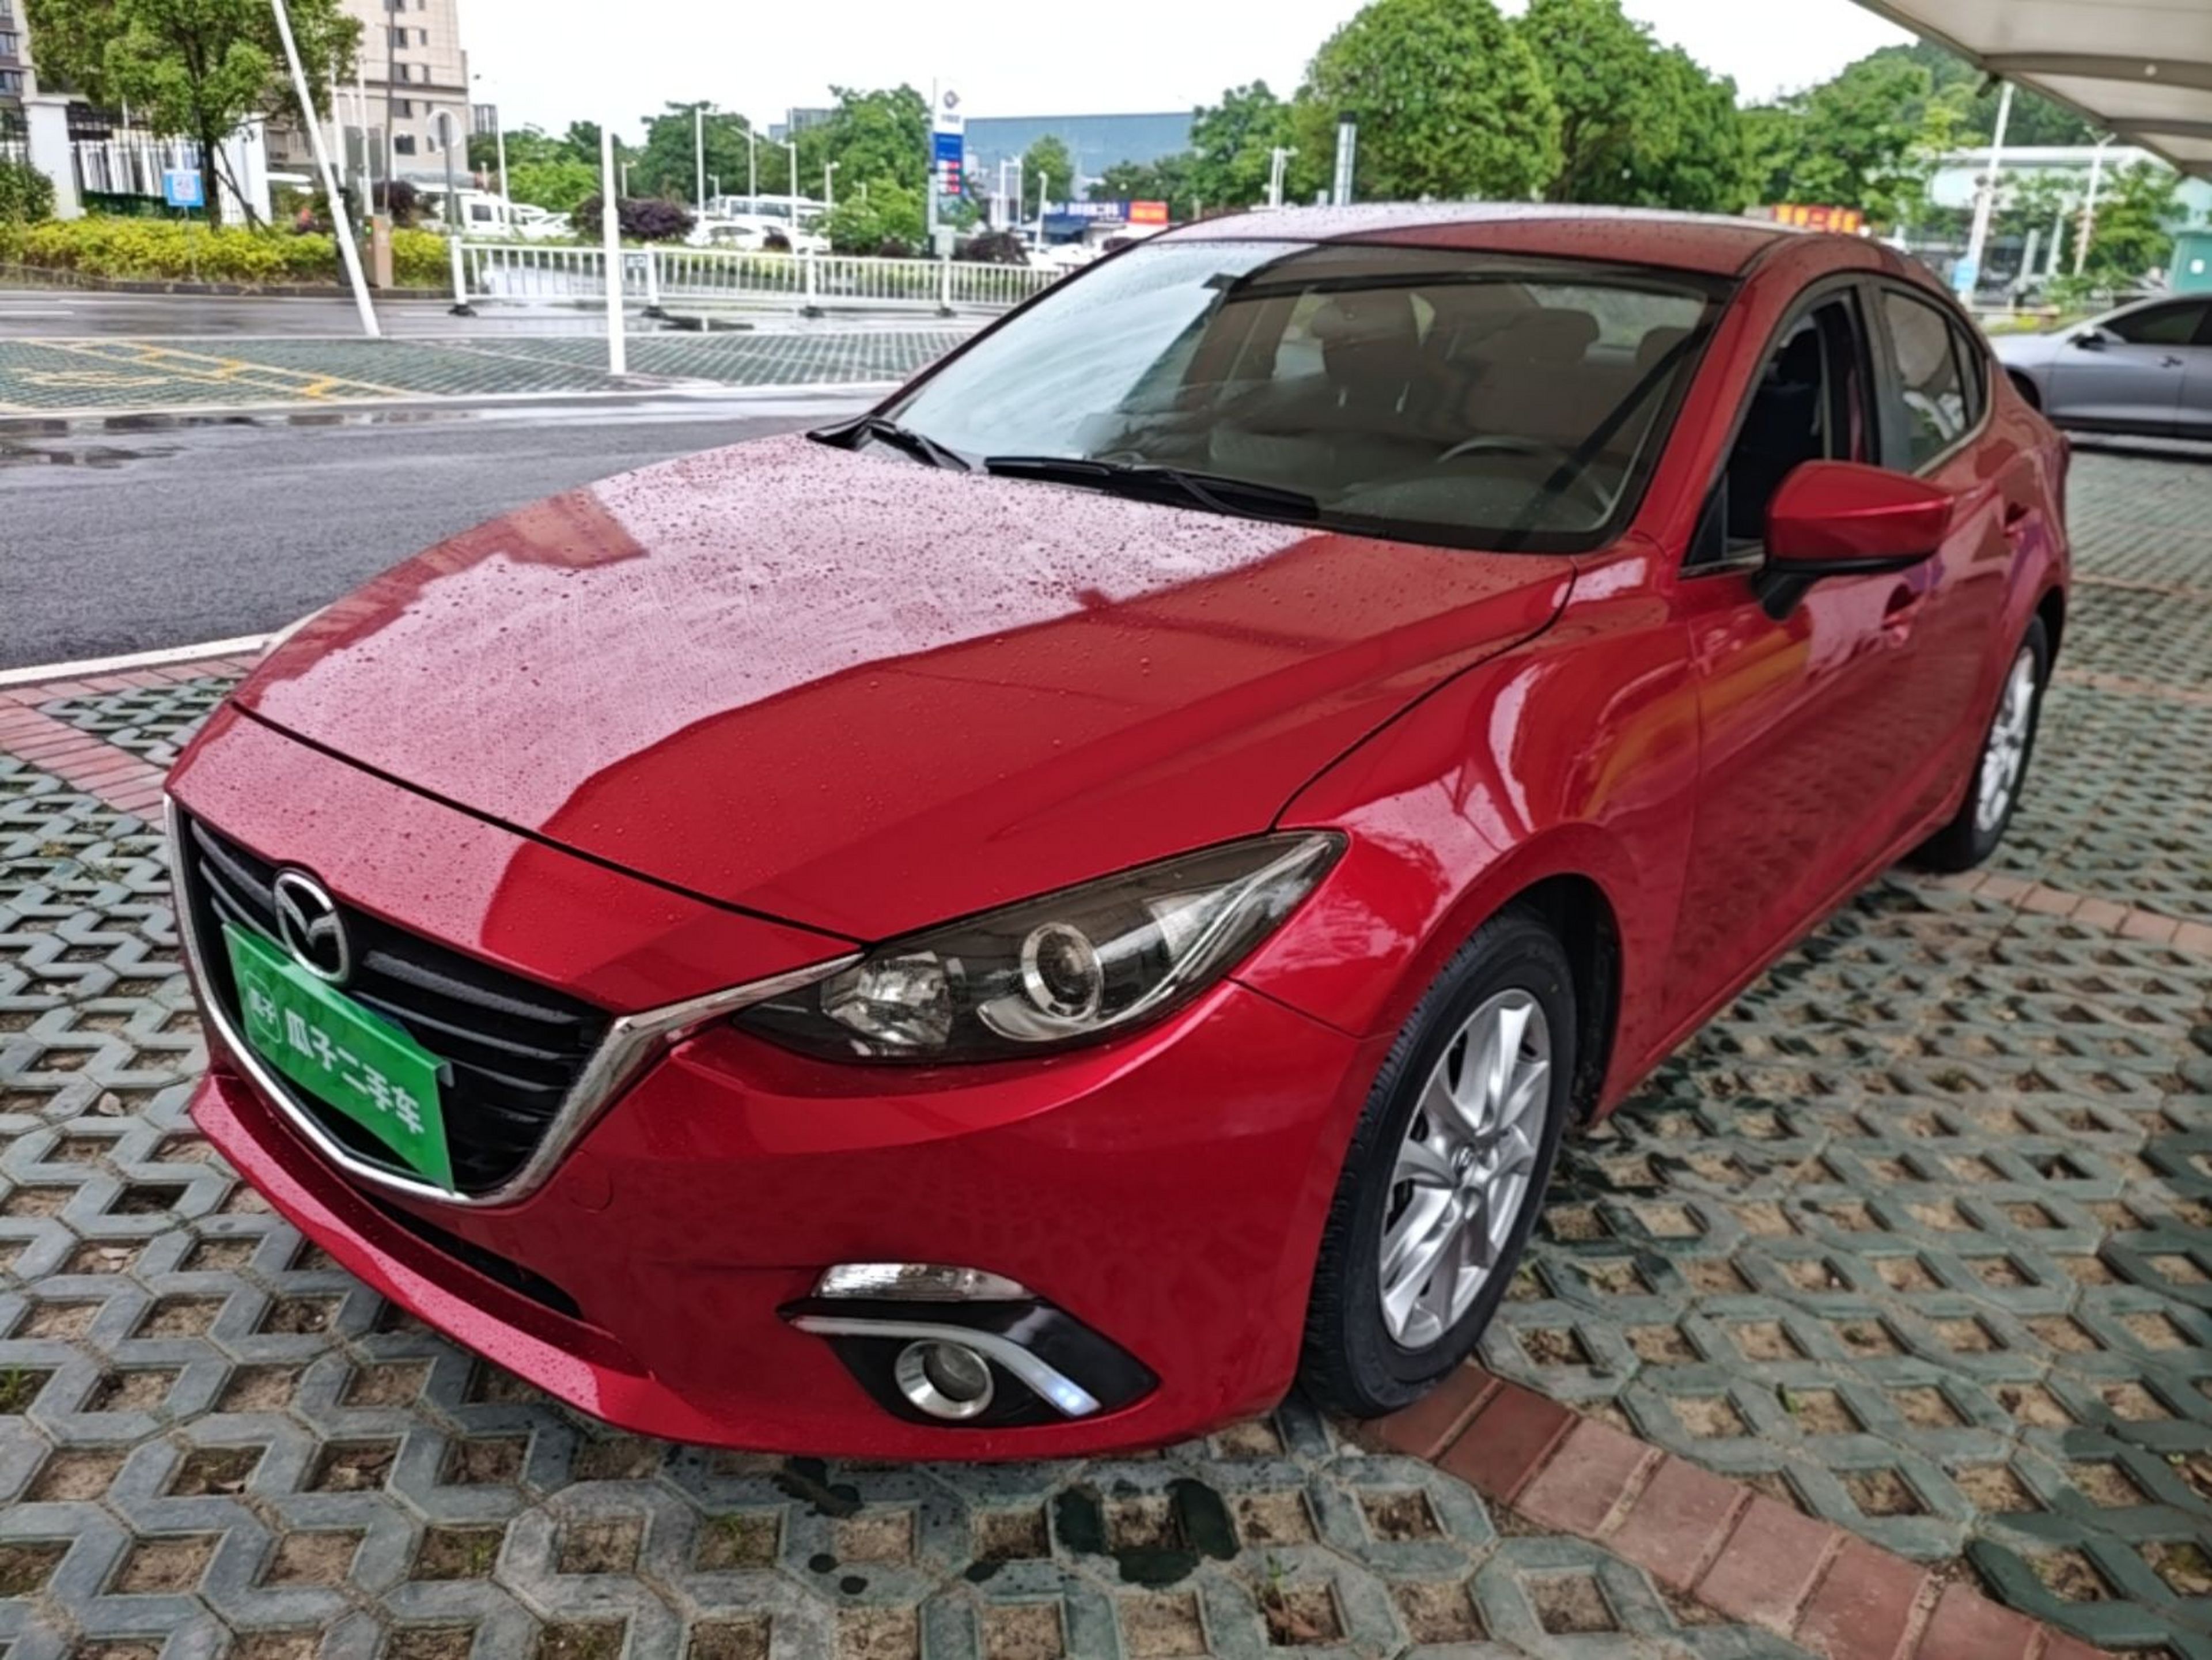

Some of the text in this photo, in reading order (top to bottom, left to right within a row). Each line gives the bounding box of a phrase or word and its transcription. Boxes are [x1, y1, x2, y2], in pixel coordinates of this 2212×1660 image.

[285, 1008, 424, 1134] 瓜子二手车
